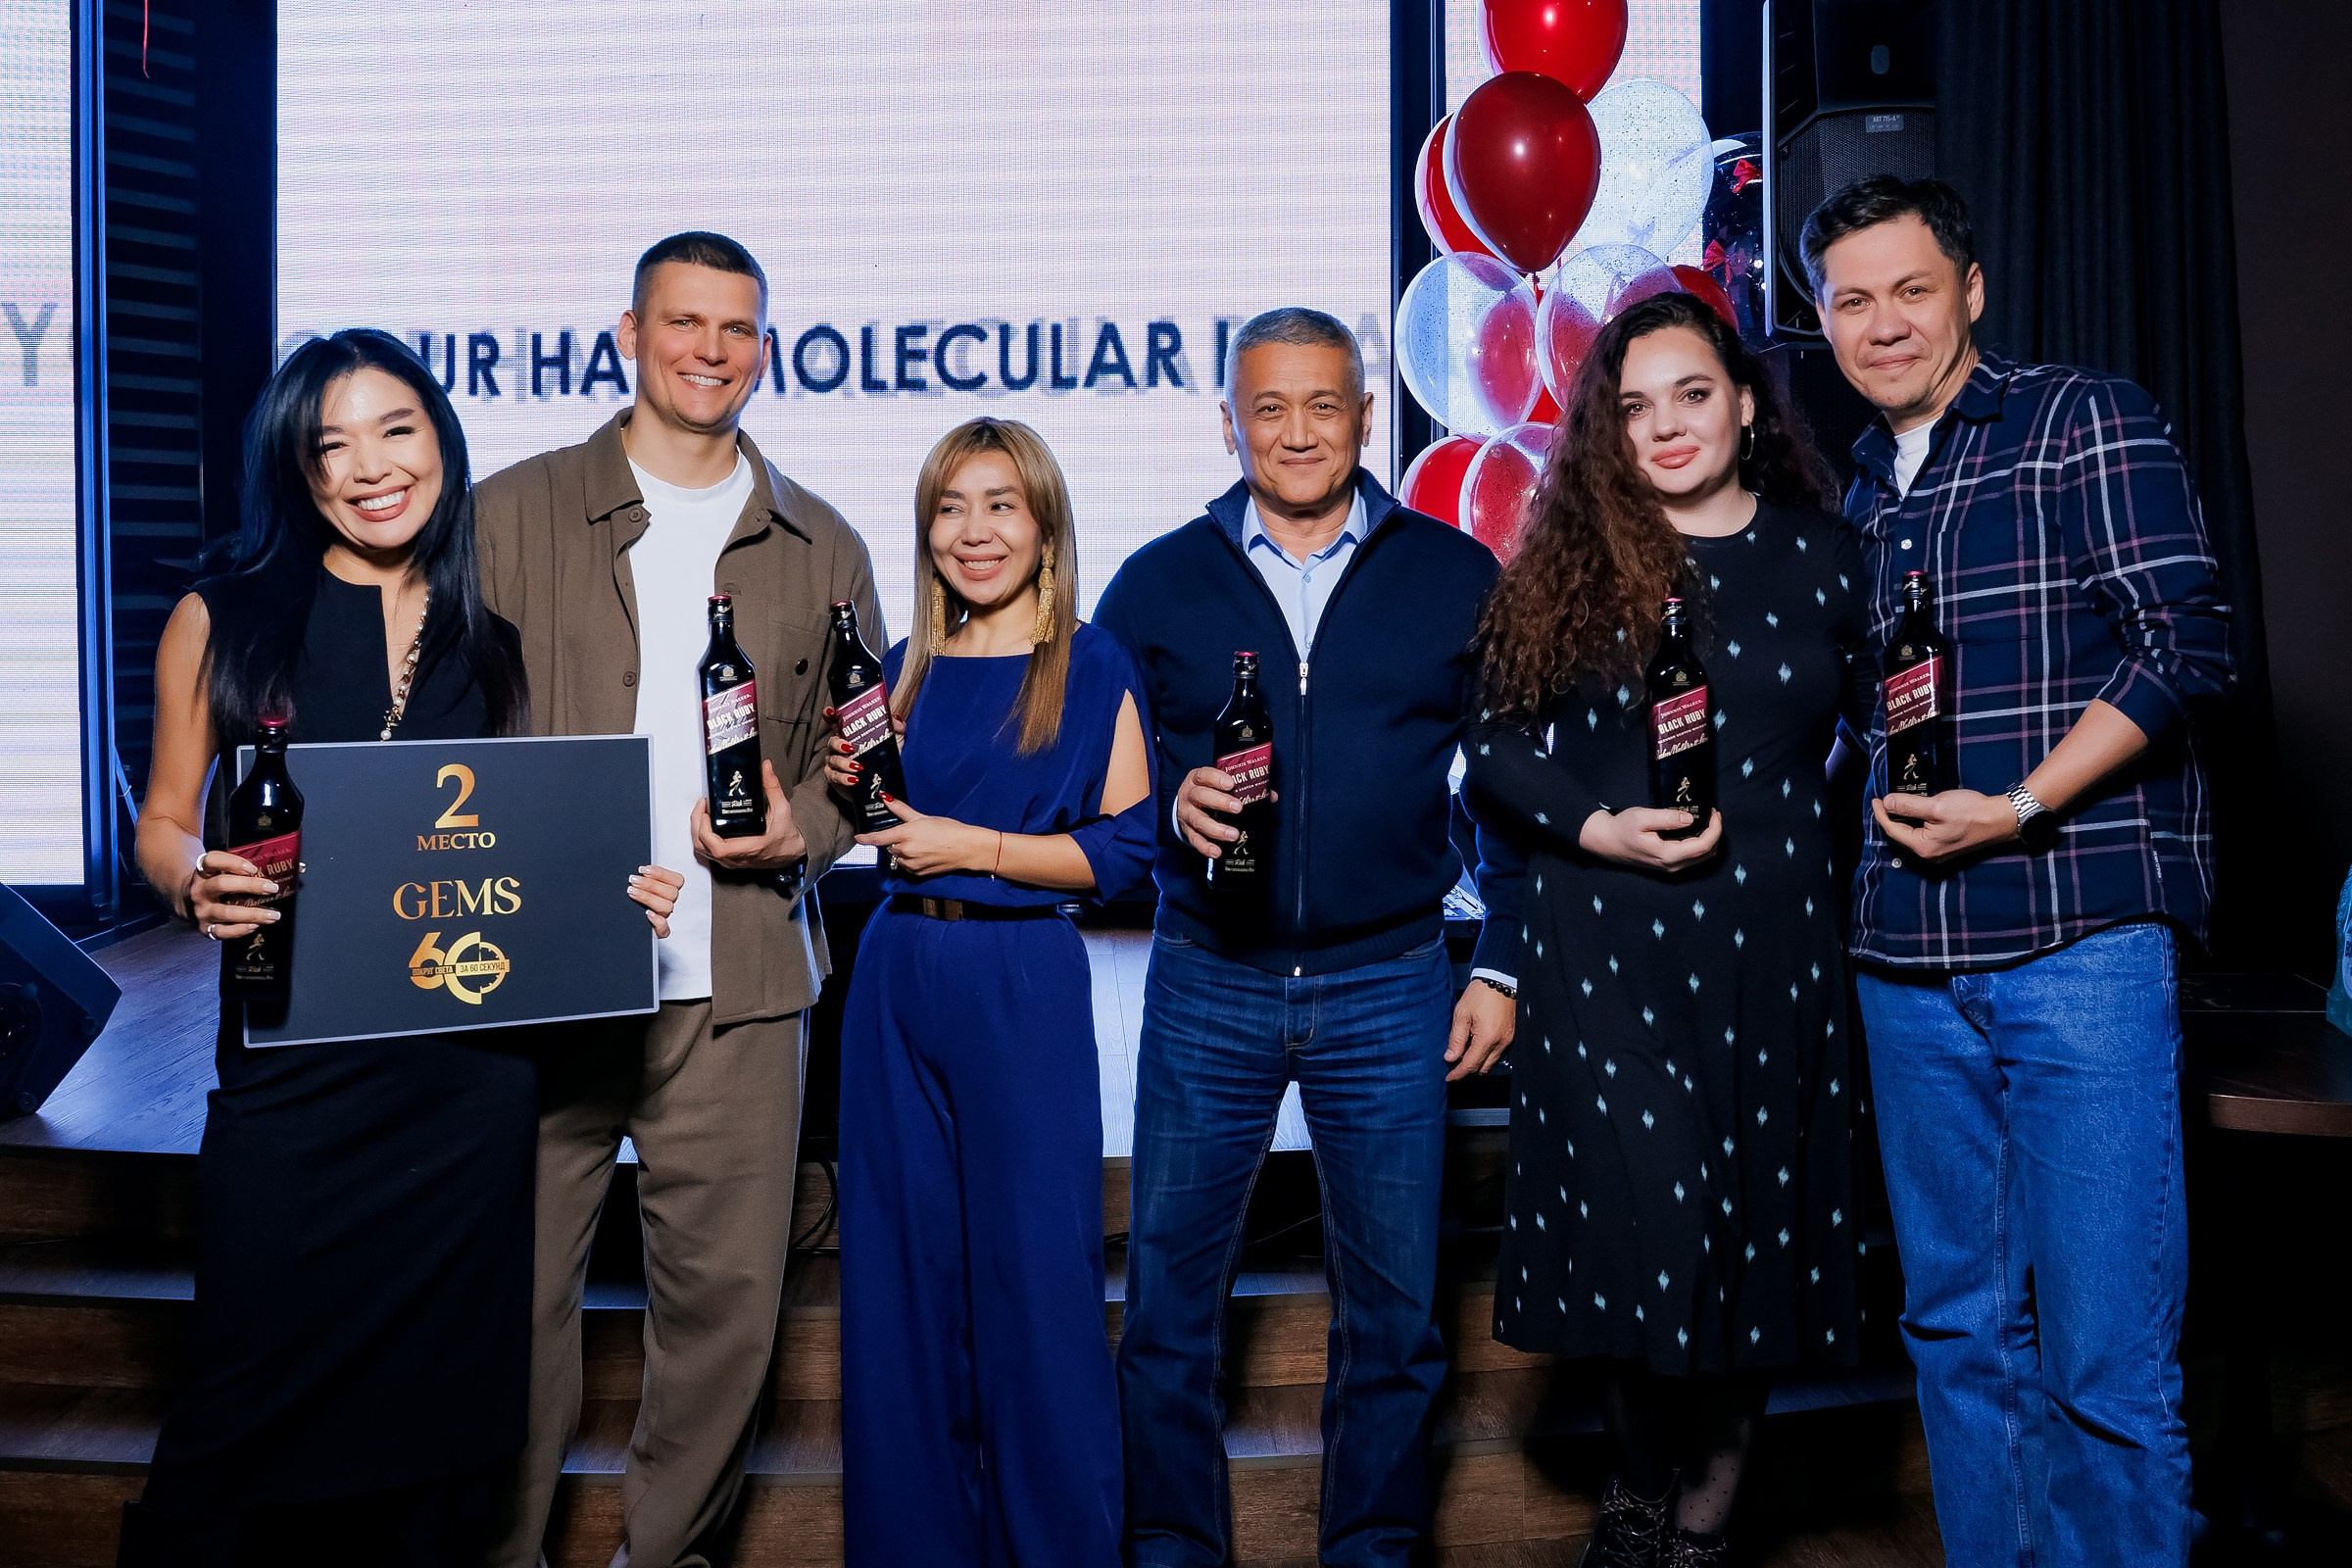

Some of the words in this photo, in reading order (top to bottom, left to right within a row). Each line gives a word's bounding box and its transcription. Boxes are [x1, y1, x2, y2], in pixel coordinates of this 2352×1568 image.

[531, 331, 630, 395] HA
[1886, 692, 1912, 711] BLACK
[1912, 681, 1934, 700] RUBY
[707, 711, 733, 730] BLACK
[733, 703, 755, 719] RUBY
[842, 716, 867, 737] BLACK
[865, 705, 887, 723] RUBY
[1657, 716, 1685, 735] BLACK
[1684, 709, 1706, 724] RUBY
[1249, 765, 1269, 780] RUBY
[435, 763, 479, 829] 2
[416, 832, 497, 851] МЕСТО
[267, 858, 293, 875] RUBY
[393, 877, 521, 920] GEMS
[460, 964, 469, 973] ЗА
[470, 963, 478, 972] 60
[479, 962, 505, 971] СЕКУНД
